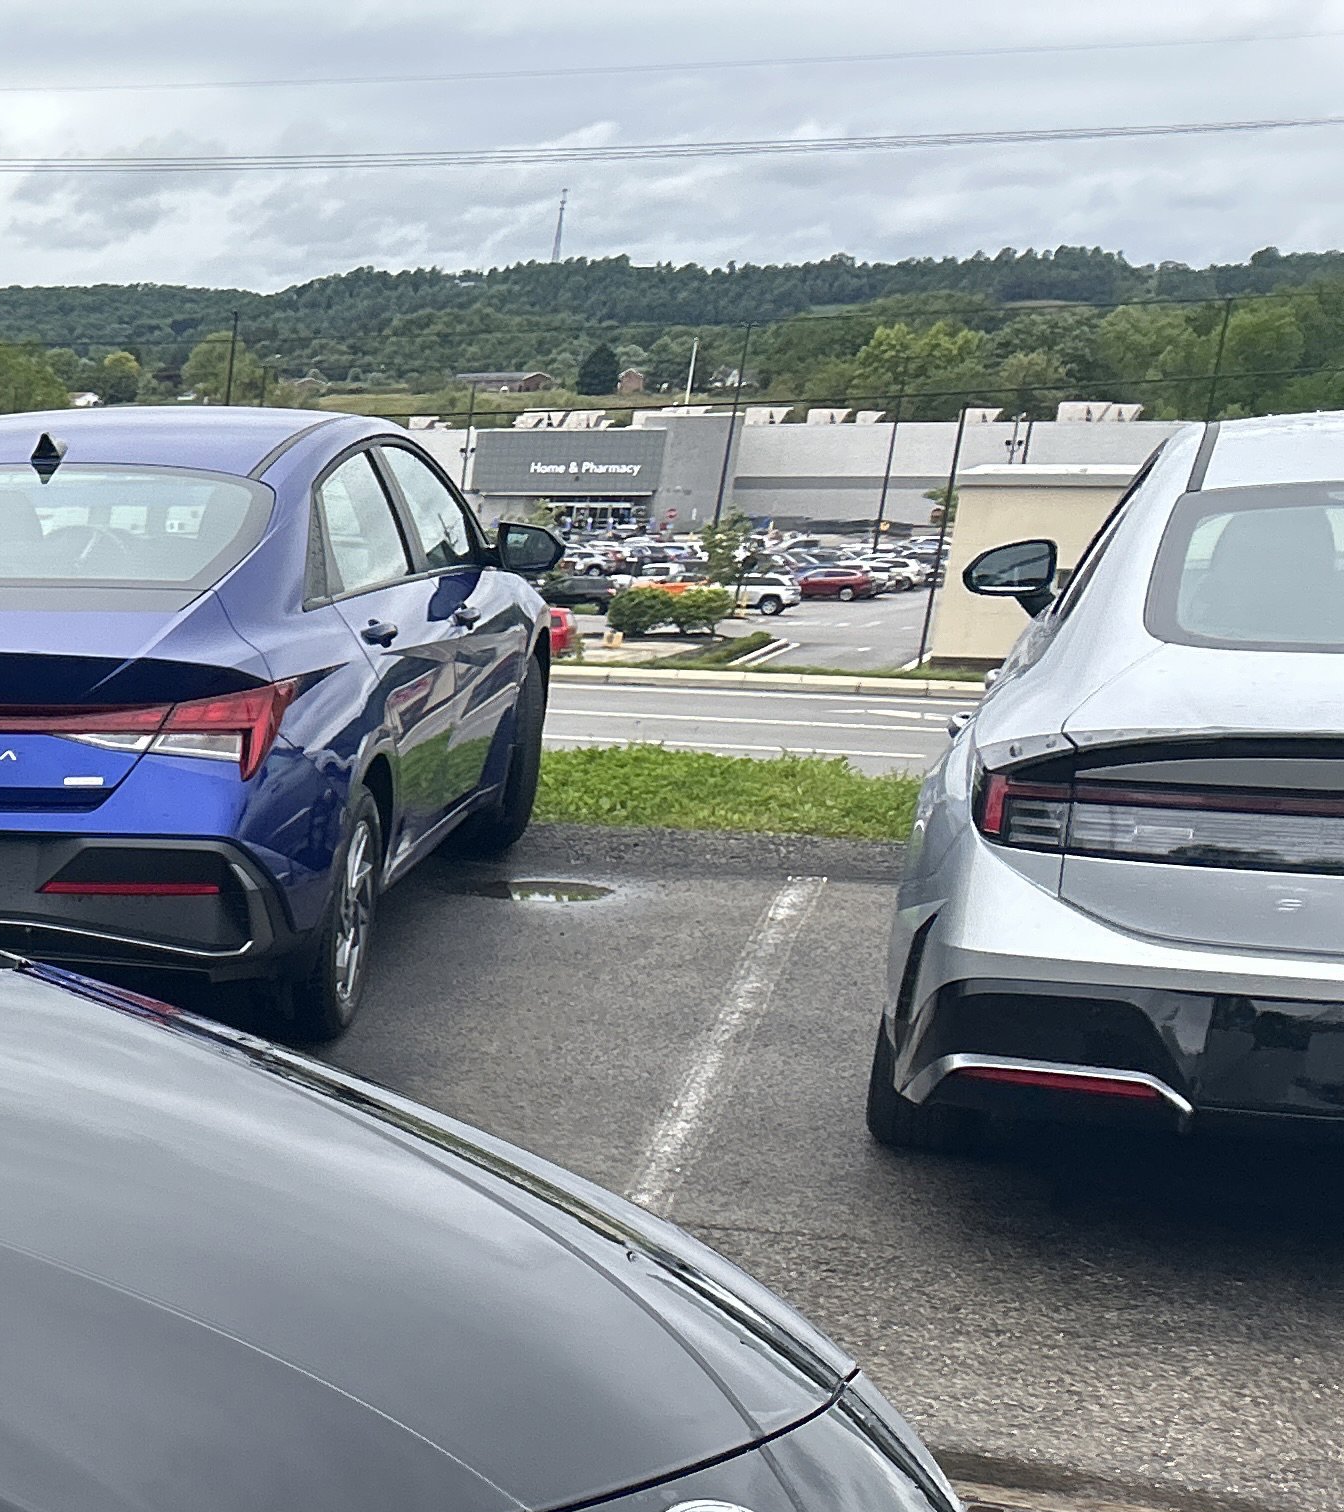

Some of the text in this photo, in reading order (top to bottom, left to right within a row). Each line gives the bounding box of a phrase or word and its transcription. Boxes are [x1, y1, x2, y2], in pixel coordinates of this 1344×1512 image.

[530, 461, 641, 476] Home & Pharmacy
